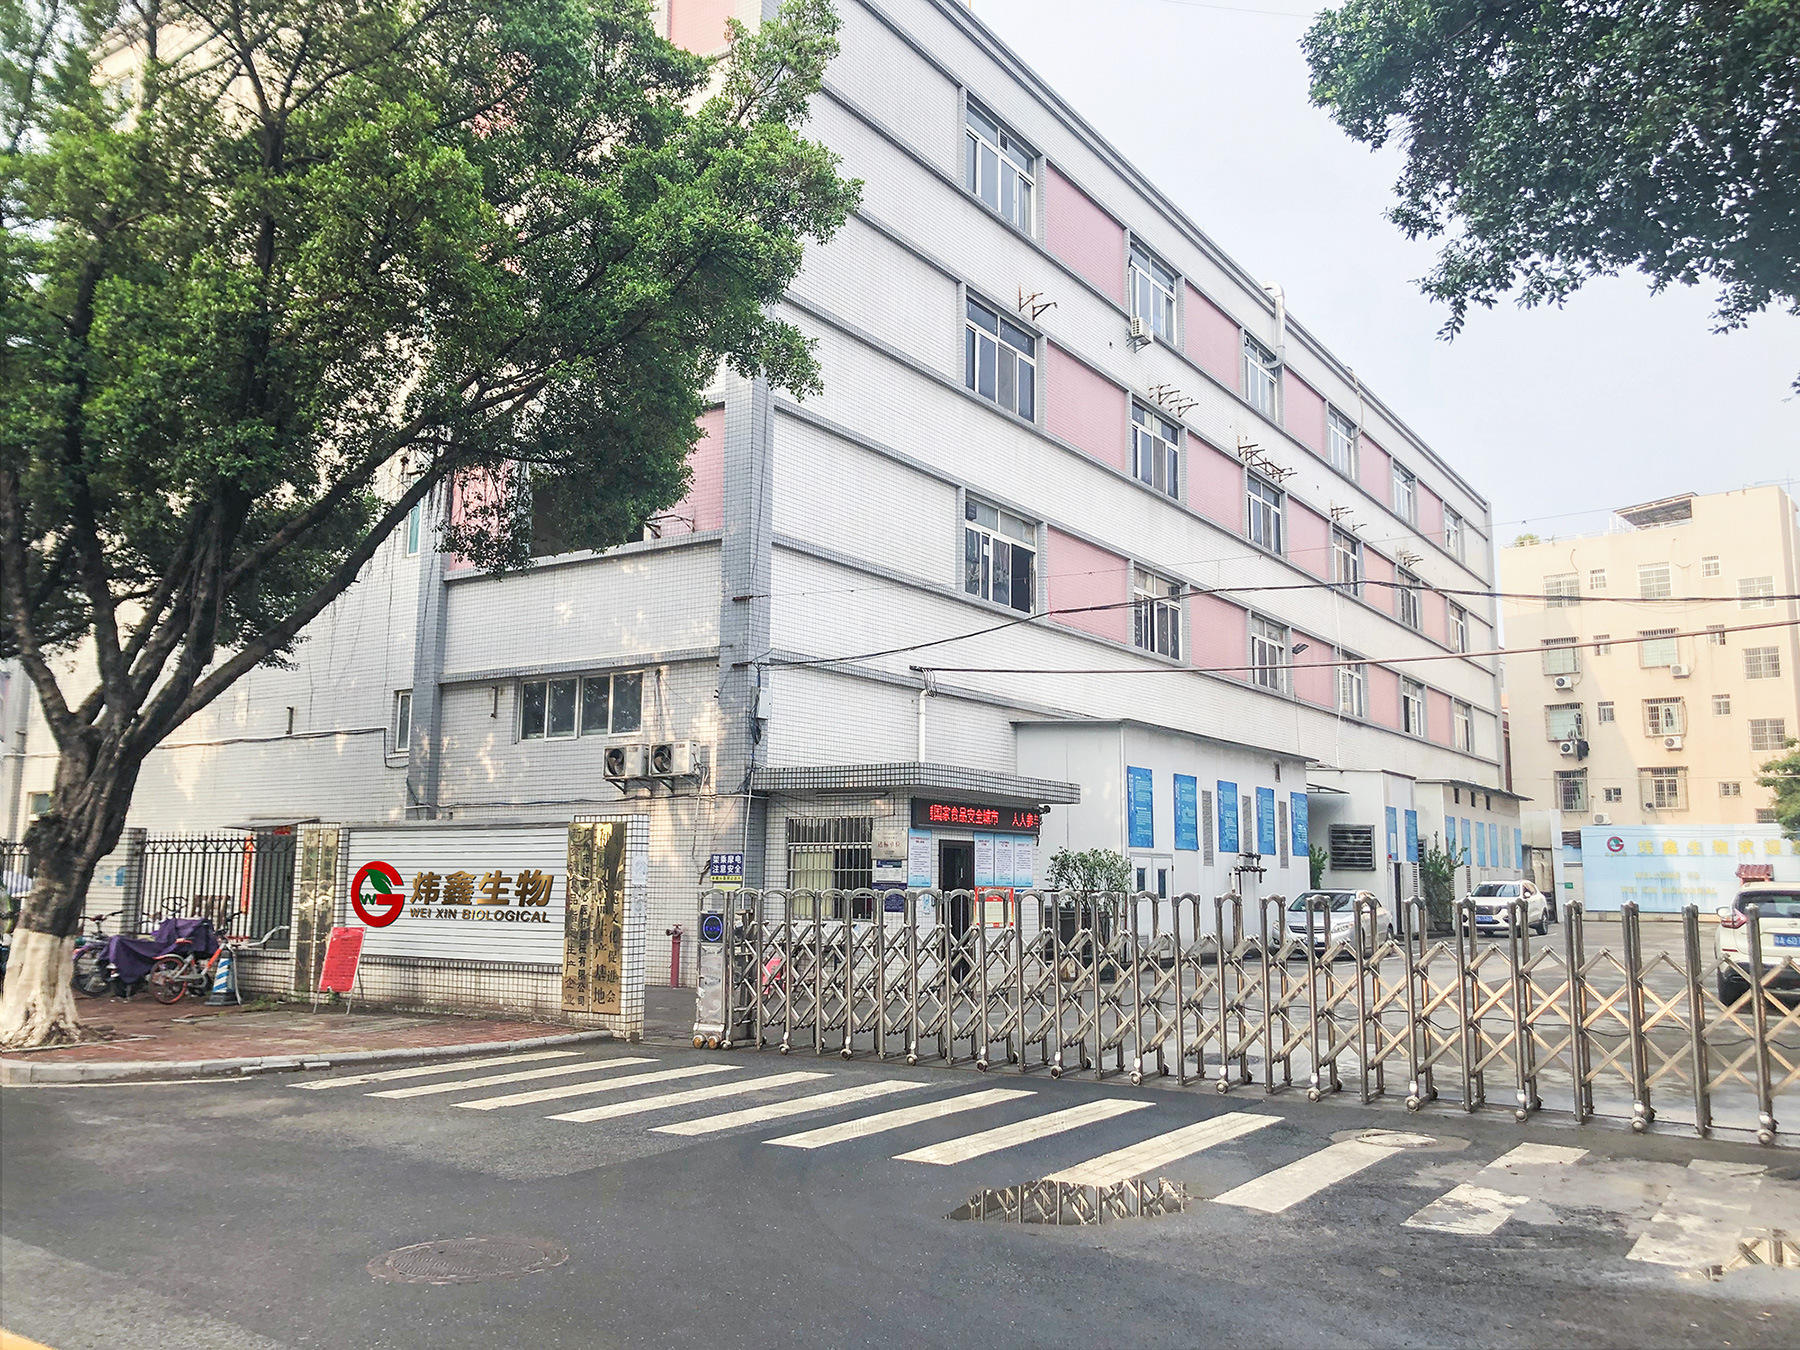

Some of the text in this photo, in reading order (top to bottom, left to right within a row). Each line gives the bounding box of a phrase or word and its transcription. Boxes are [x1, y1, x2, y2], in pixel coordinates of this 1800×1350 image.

[712, 864, 741, 874] 注意安全
[410, 869, 554, 906] 炜鑫生物
[410, 908, 551, 923] WEI XIN BIOLOGICAL
